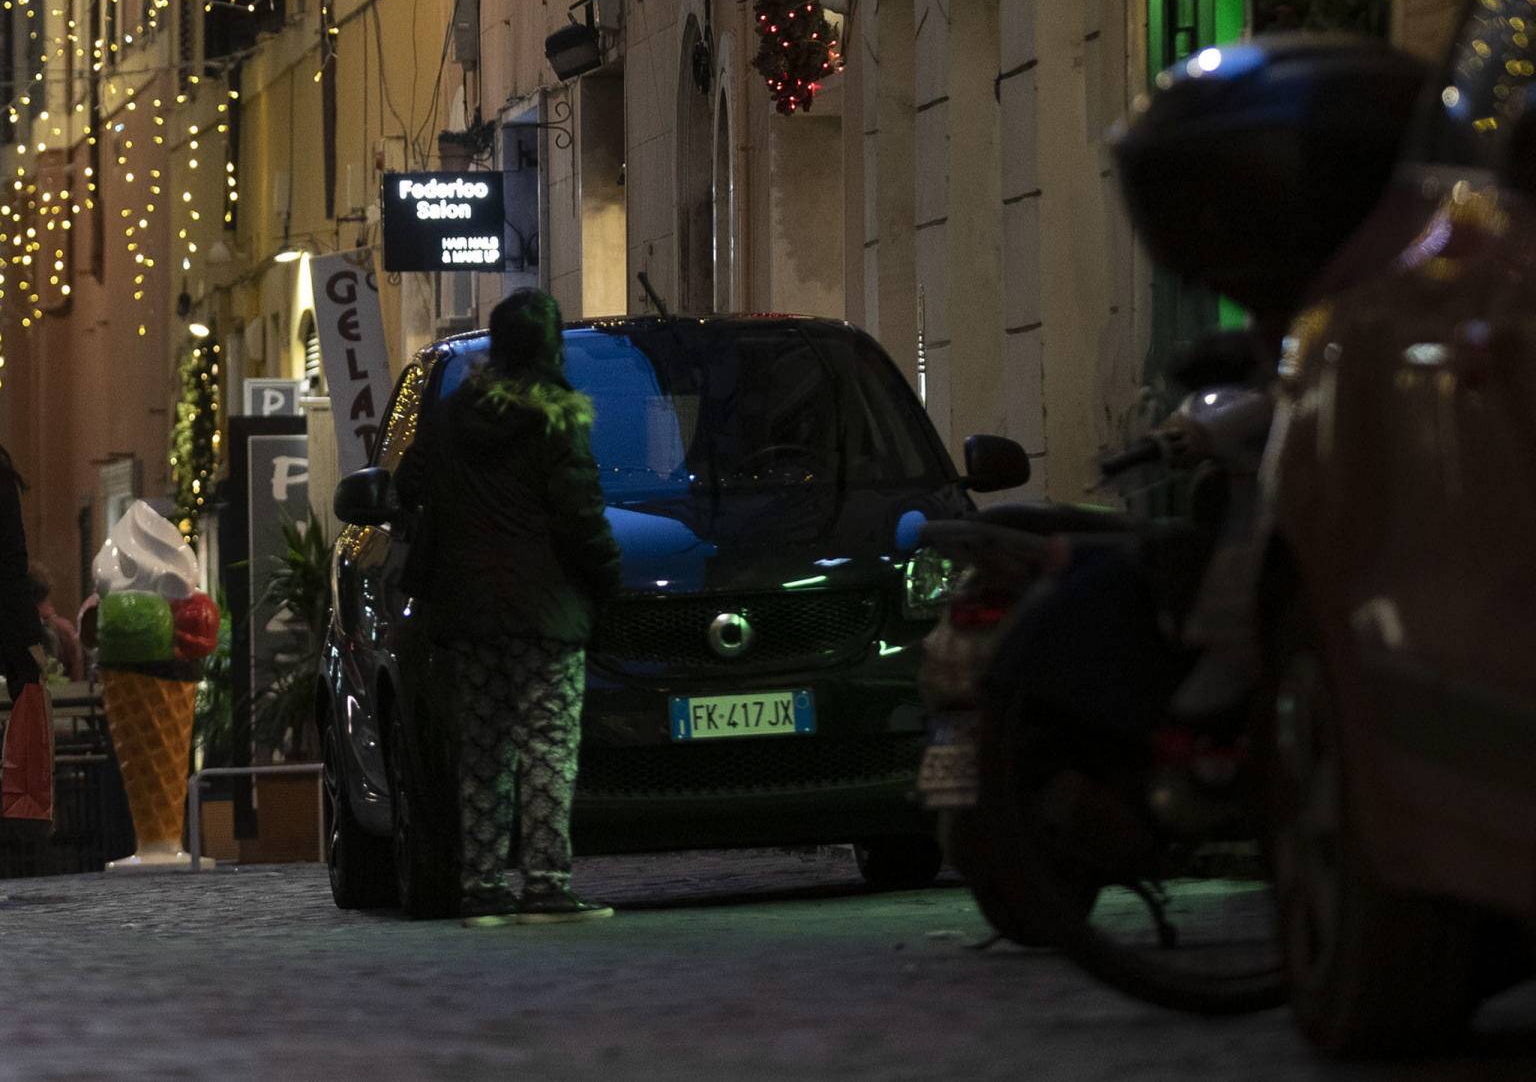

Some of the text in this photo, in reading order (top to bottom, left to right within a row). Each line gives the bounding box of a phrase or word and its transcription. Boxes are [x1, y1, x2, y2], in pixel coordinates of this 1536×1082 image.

[399, 178, 488, 199] Federico
[416, 199, 472, 219] Salon
[442, 236, 499, 250] HAIR NAILS
[484, 250, 500, 263] UP
